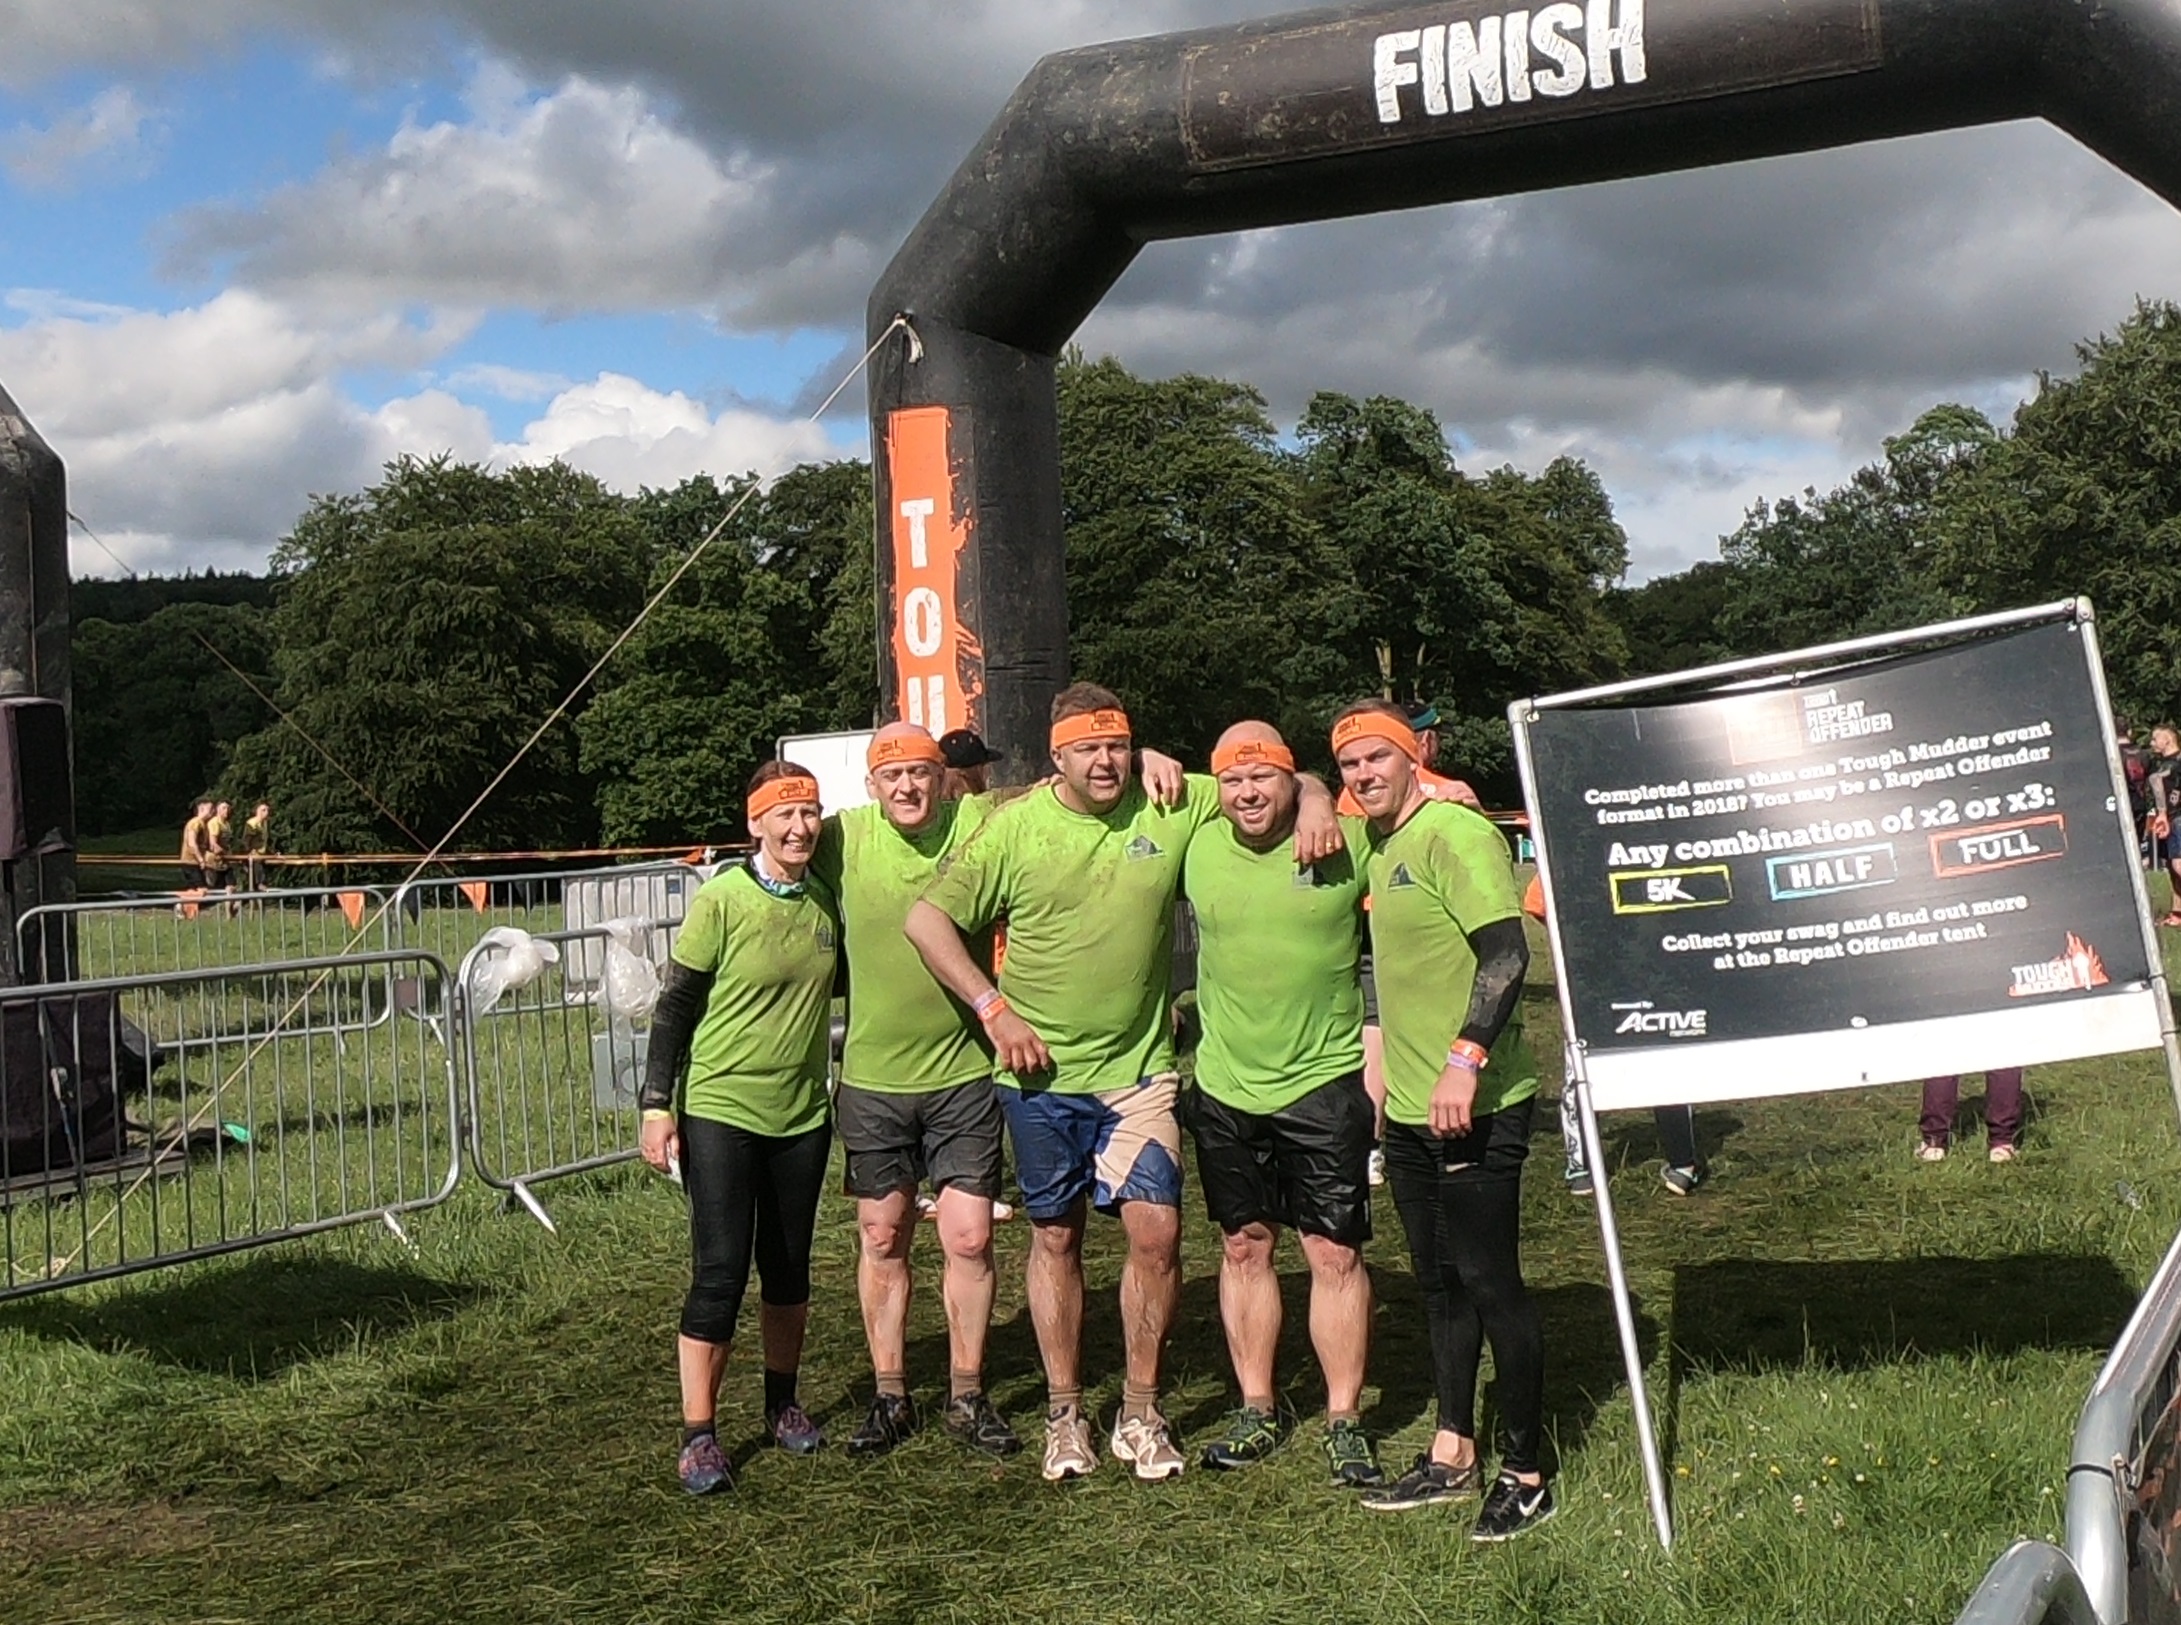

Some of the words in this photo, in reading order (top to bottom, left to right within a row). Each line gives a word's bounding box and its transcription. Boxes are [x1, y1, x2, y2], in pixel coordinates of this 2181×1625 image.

[1372, 0, 1647, 124] FINISH
[1805, 700, 1866, 728] REPEAT
[1809, 712, 1893, 743] OFFENDER
[1585, 779, 1691, 805] Completed
[1693, 777, 1746, 796] more
[1749, 770, 1796, 790] than
[1801, 762, 1837, 781] one
[1838, 748, 1906, 773] Tough
[1908, 734, 1990, 762] Mudder
[1991, 720, 2053, 746] event
[1597, 804, 1666, 825] format
[1667, 803, 1690, 819] in
[1692, 795, 1749, 817] 2018?
[1750, 790, 1791, 809] You
[1792, 785, 1837, 804] may
[1839, 780, 1865, 796] be
[1868, 777, 1882, 791] a
[1883, 763, 1956, 788] Repeat
[1958, 746, 2051, 775] Offender
[1608, 842, 1669, 868] Any
[1674, 817, 1876, 860] combination
[1881, 806, 1916, 834] of
[1920, 799, 1959, 827] x2
[1964, 795, 2001, 820] or
[2006, 783, 2056, 812] x3:
[1958, 829, 2041, 864] FULL
[1789, 855, 1873, 889] HALF
[1646, 876, 1696, 904] 5K
[1662, 931, 1732, 952] Collect
[1734, 927, 1783, 949] your
[1787, 920, 1839, 940] swag
[1843, 914, 1883, 934] and
[1886, 906, 1930, 929] find
[1933, 902, 1969, 921] out
[1972, 895, 2029, 916] more
[1714, 955, 1735, 970] at
[1736, 950, 1771, 968] the
[1774, 942, 1846, 965] Repeat
[1847, 930, 1939, 956] Offender
[1942, 922, 1988, 942] tent
[2011, 958, 2072, 985] TOUGH
[1615, 1010, 1707, 1034] ACTIVE
